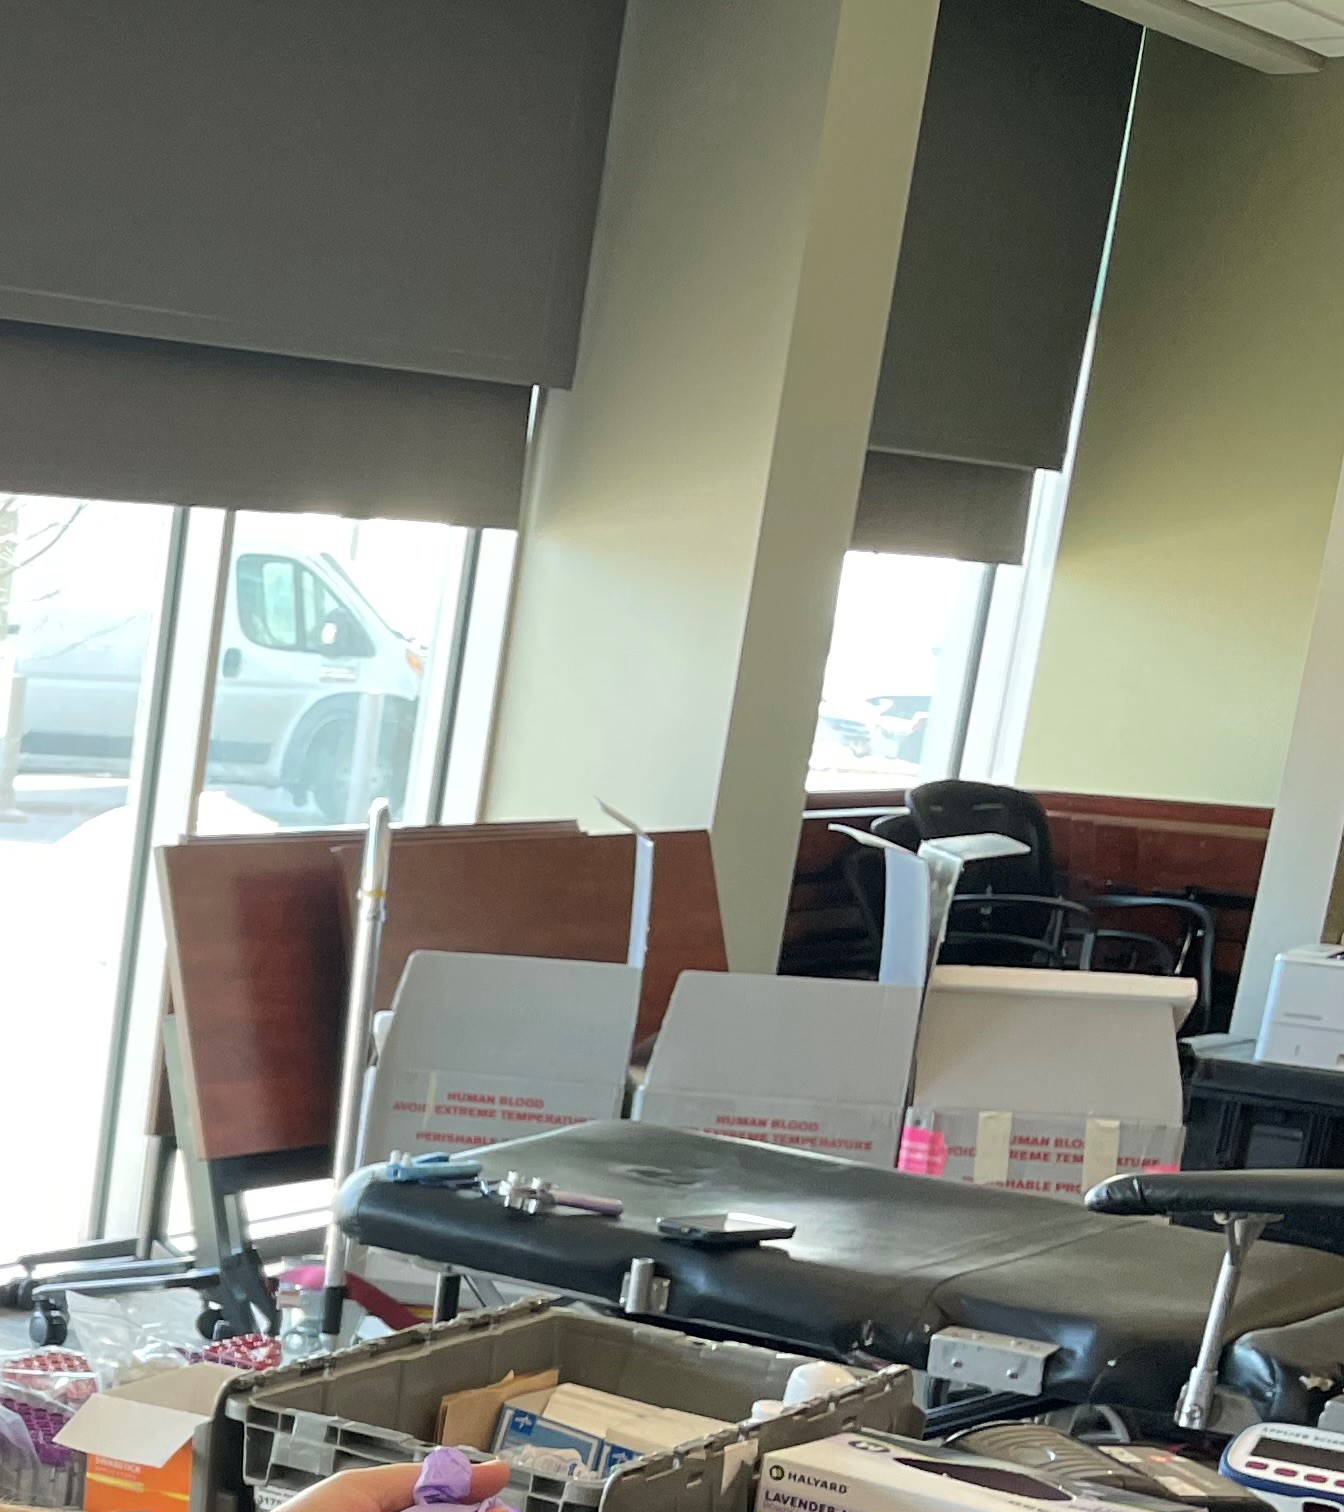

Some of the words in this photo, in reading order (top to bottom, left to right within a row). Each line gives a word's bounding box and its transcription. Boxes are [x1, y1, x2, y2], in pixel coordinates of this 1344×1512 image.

[446, 1091, 496, 1105] HUMAN
[499, 1096, 545, 1110] BLOOD
[435, 1104, 497, 1119] EXTREME
[501, 1109, 596, 1126] TEMPERATUR
[715, 1114, 767, 1128] HUMAN
[770, 1118, 819, 1132] BLOOD
[415, 1130, 496, 1146] PERISHABLE
[773, 1133, 873, 1151] TEMPERATURE
[787, 1471, 848, 1494] HALYARD
